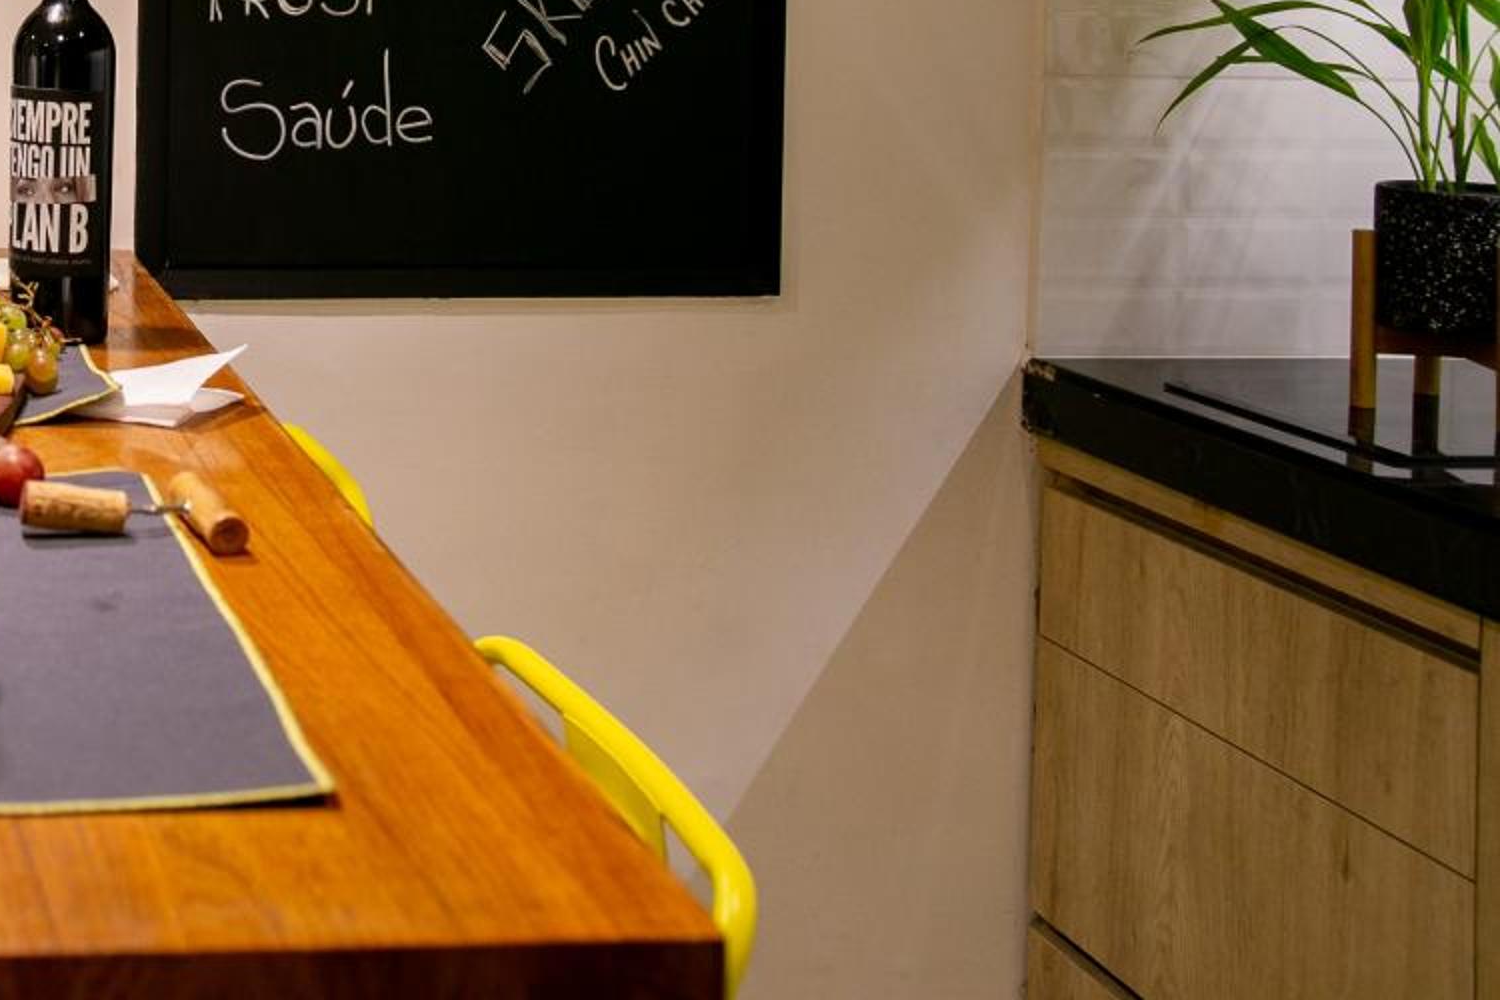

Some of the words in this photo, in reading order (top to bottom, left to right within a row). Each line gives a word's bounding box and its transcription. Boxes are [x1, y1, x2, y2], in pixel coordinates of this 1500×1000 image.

[11, 99, 93, 145] IEMPRE
[220, 48, 434, 161] Saúde
[11, 143, 55, 180] ENGO
[9, 200, 61, 253] LAN
[69, 203, 89, 254] B
